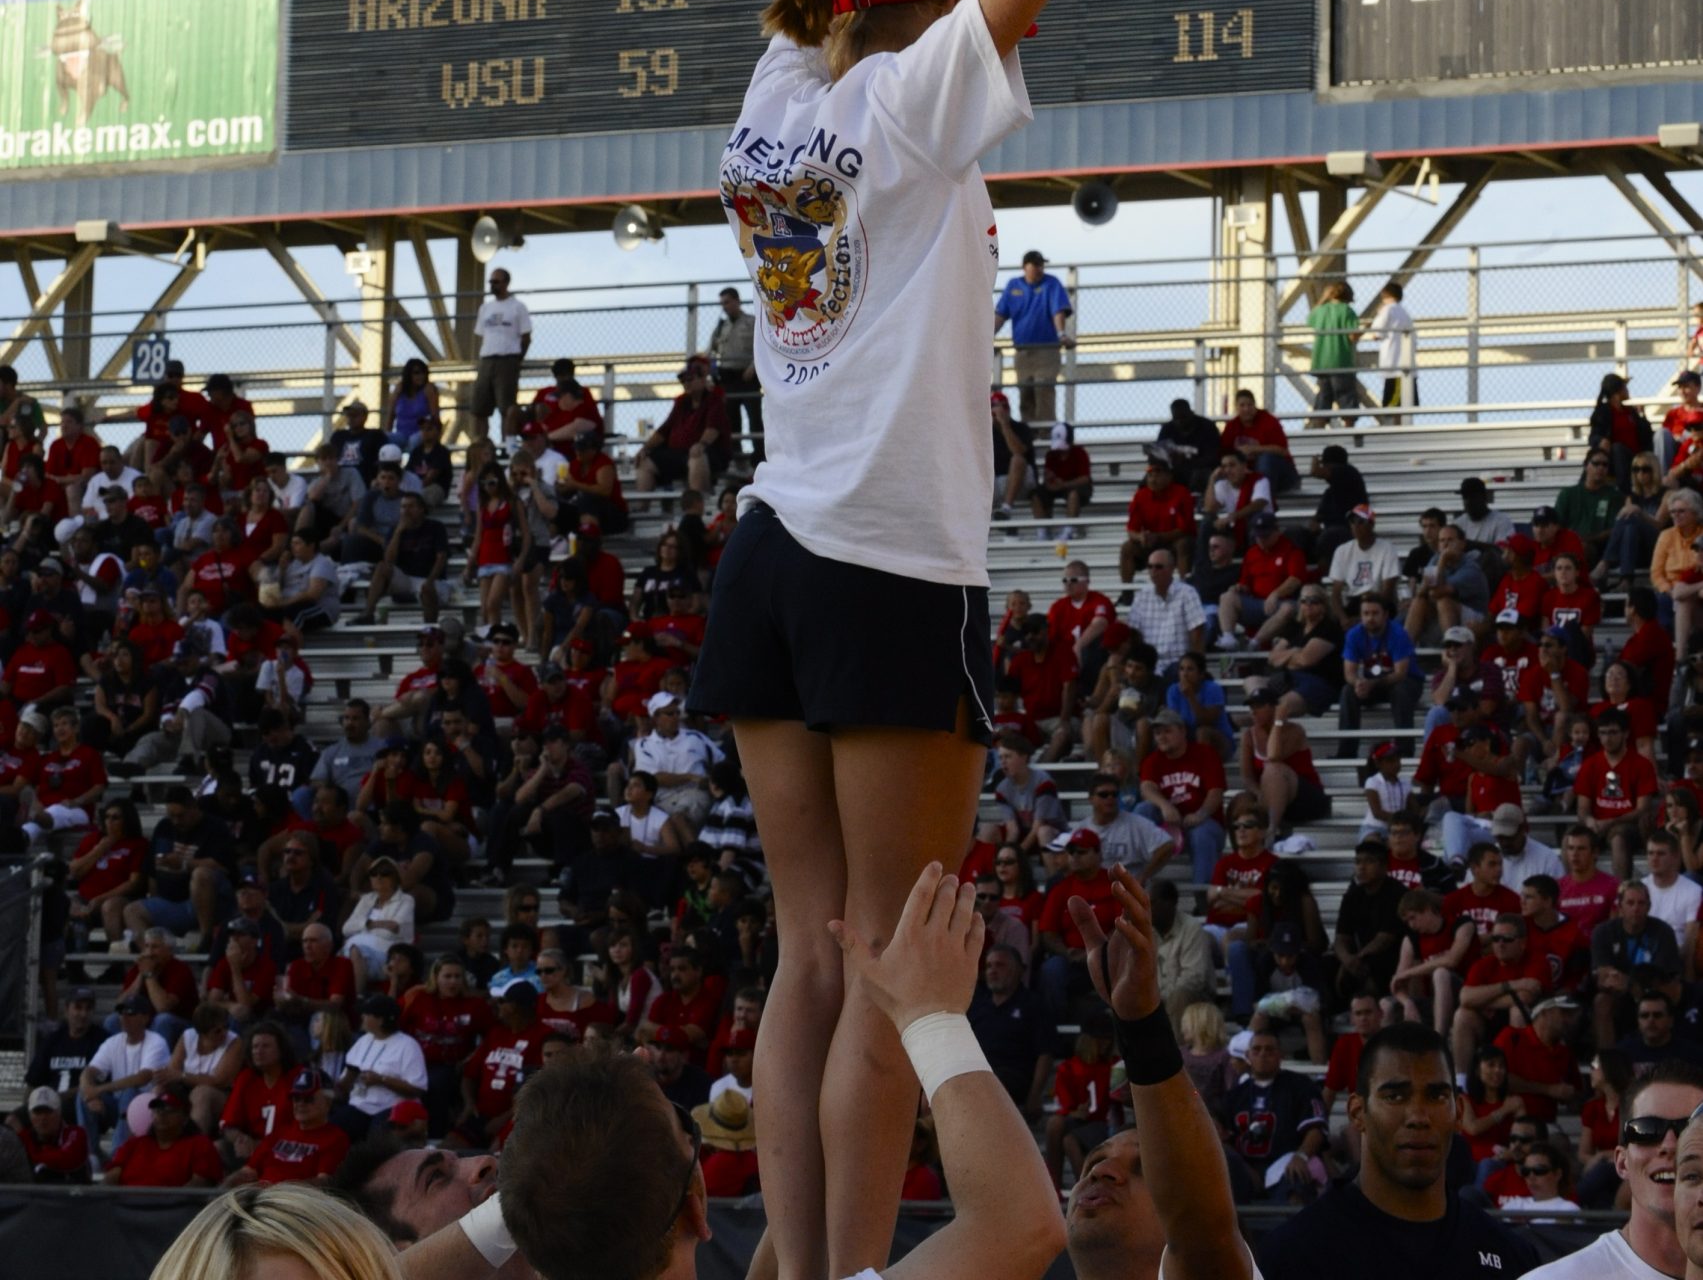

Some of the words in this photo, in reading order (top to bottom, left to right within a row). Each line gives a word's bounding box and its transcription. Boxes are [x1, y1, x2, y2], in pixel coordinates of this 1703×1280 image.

[441, 57, 545, 109] WSU
[617, 47, 680, 99] 59
[1173, 7, 1255, 63] 114
[136, 341, 166, 381] 28
